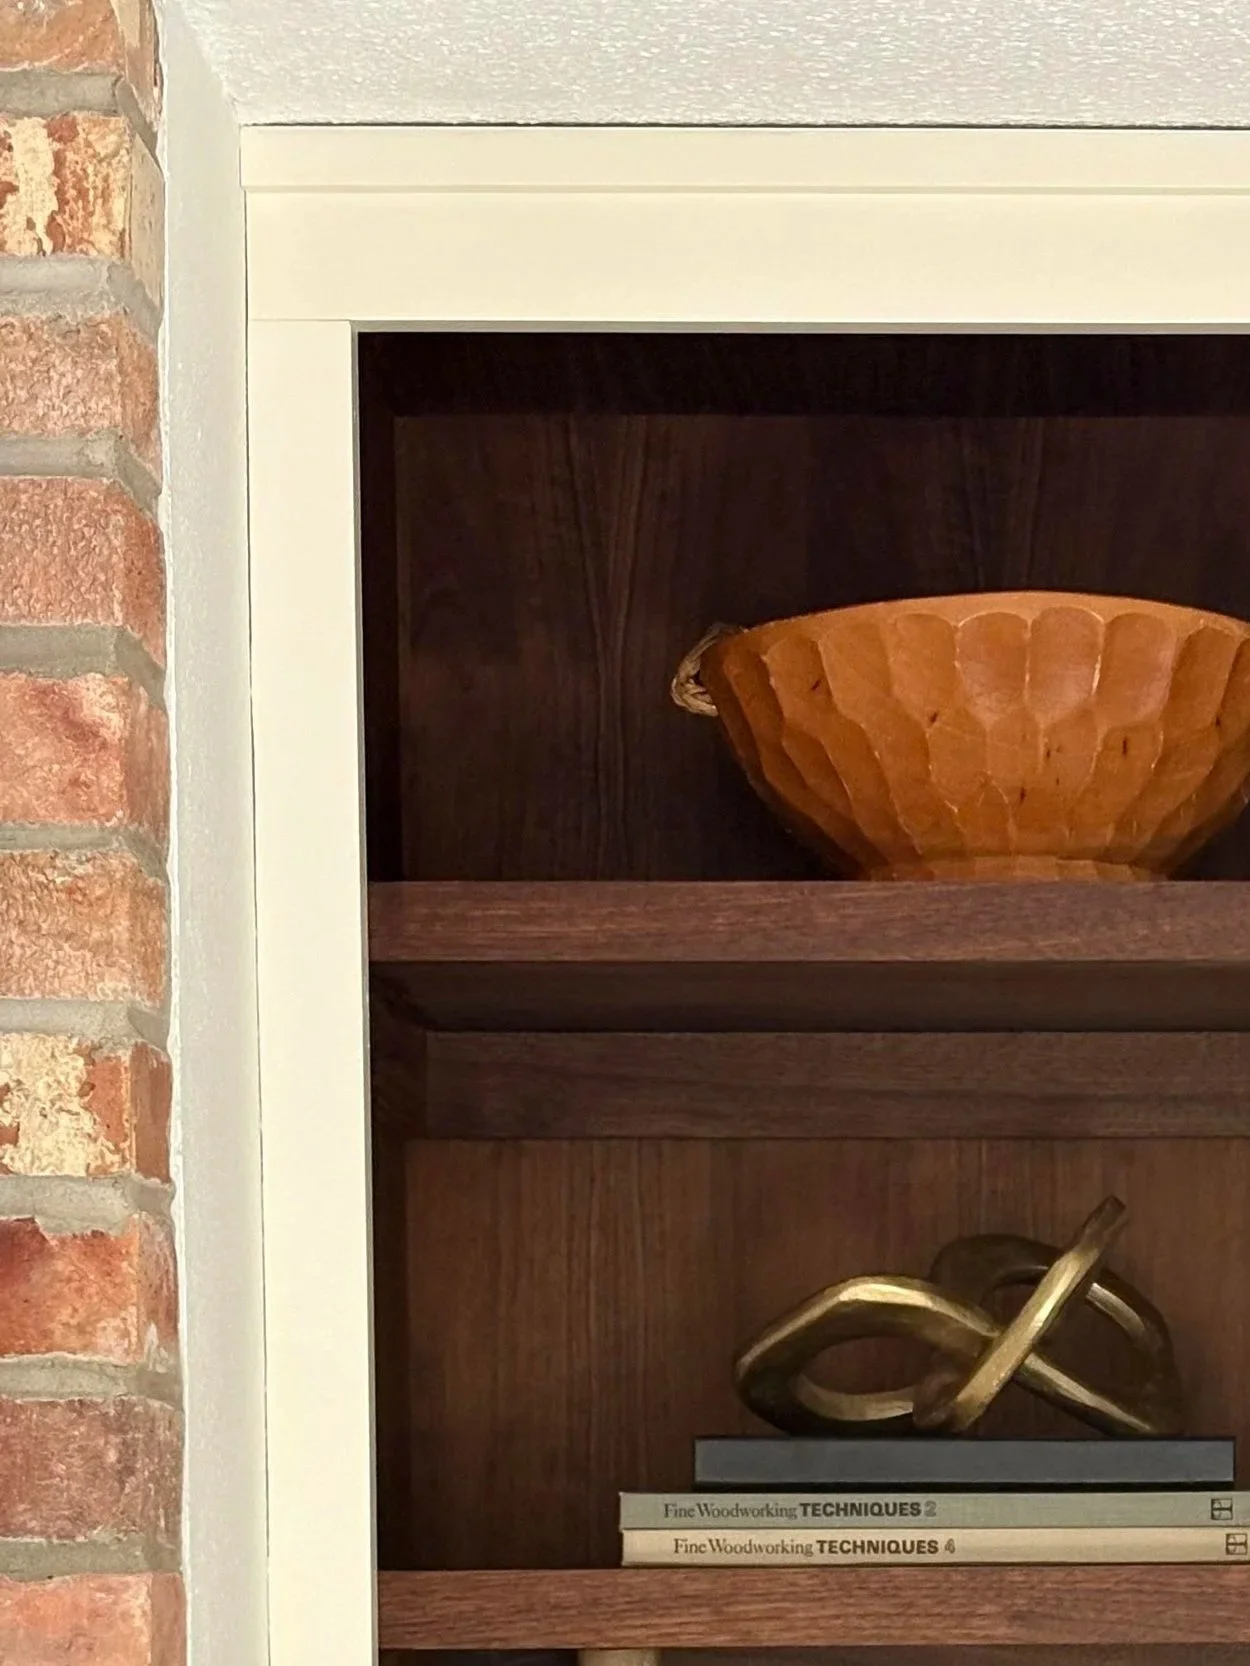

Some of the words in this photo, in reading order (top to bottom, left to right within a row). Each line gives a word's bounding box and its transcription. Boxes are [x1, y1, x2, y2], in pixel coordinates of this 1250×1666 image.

[664, 1503, 695, 1519] Fine
[697, 1502, 798, 1520] Woodworking
[800, 1502, 922, 1518] TECHNIQUES
[925, 1502, 938, 1517] 2
[673, 1538, 705, 1555] Fine
[708, 1538, 814, 1557] Woodworking
[816, 1539, 939, 1555] TECHNIQUES
